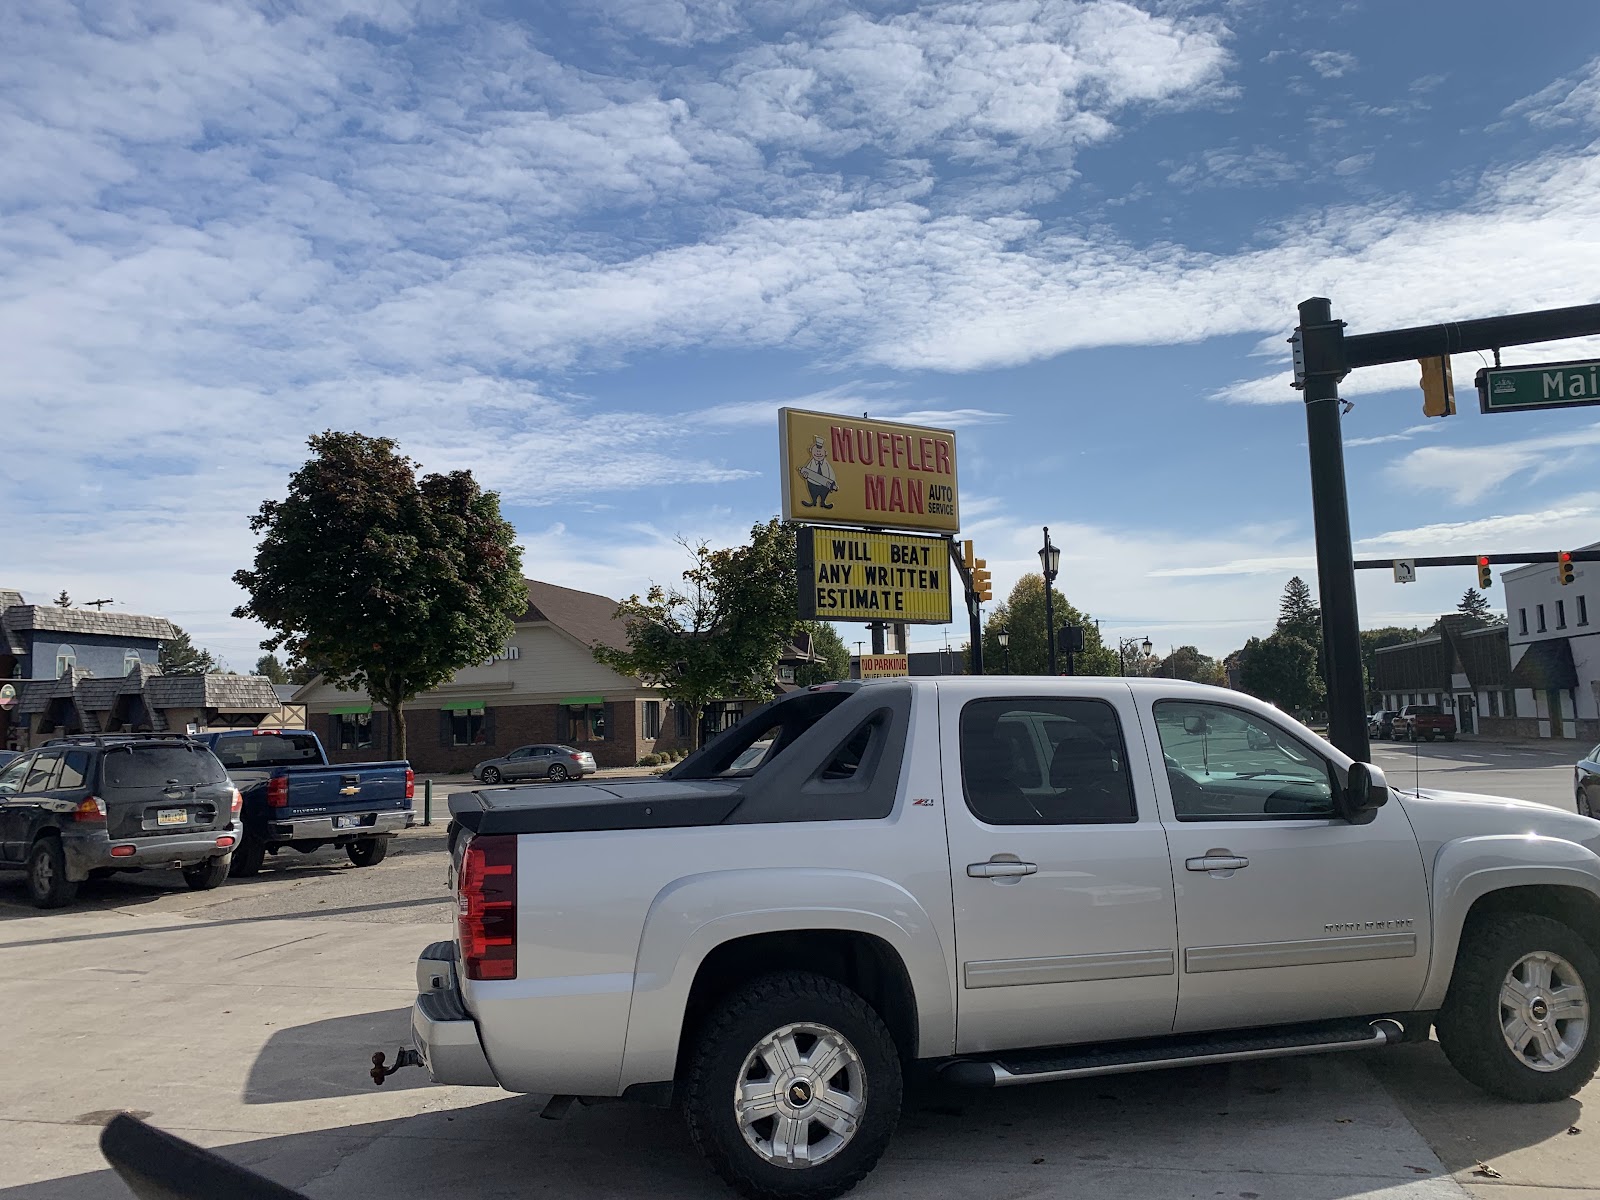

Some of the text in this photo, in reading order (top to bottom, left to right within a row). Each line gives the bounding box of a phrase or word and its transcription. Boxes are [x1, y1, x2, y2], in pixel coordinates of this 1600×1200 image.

[1542, 366, 1598, 399] Mai
[830, 426, 951, 475] MUFFLER
[865, 474, 924, 514] MAN
[928, 484, 953, 502] AUTO
[928, 503, 954, 516] SERVICE
[832, 540, 930, 566] WILL BEAT
[818, 563, 939, 590] ANY WRITTEN
[817, 587, 904, 611] ESTIMATE
[862, 658, 907, 671] NO PARKING
